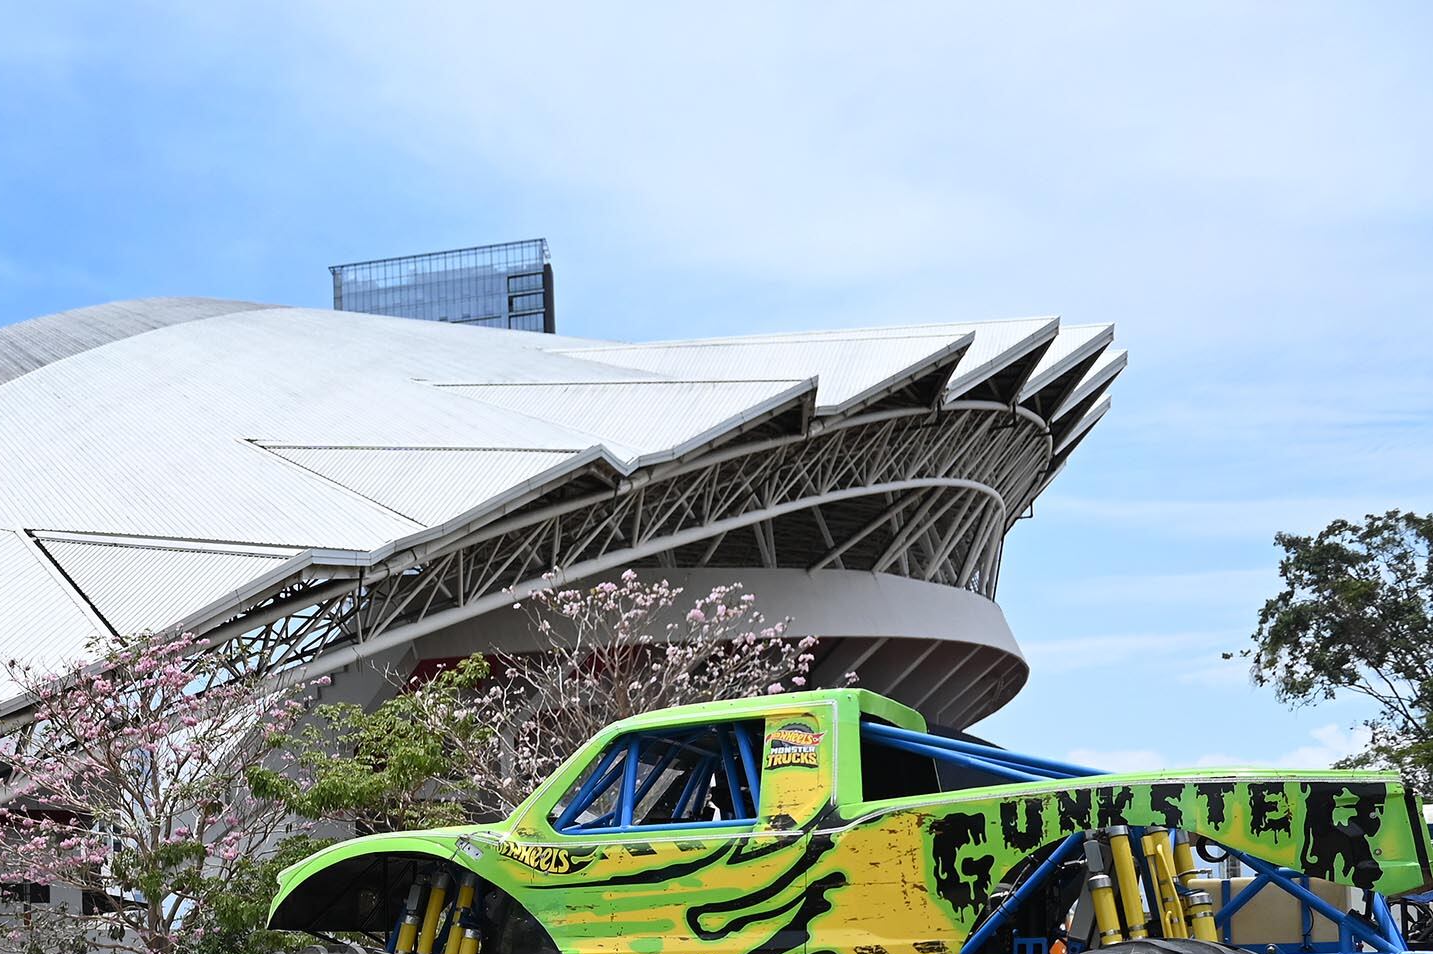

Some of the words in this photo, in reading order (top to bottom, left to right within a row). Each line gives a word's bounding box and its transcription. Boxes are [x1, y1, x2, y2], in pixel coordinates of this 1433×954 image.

[770, 745, 816, 755] MONSTER
[766, 752, 819, 769] TRUCKS
[929, 782, 1388, 924] GUNKSTER
